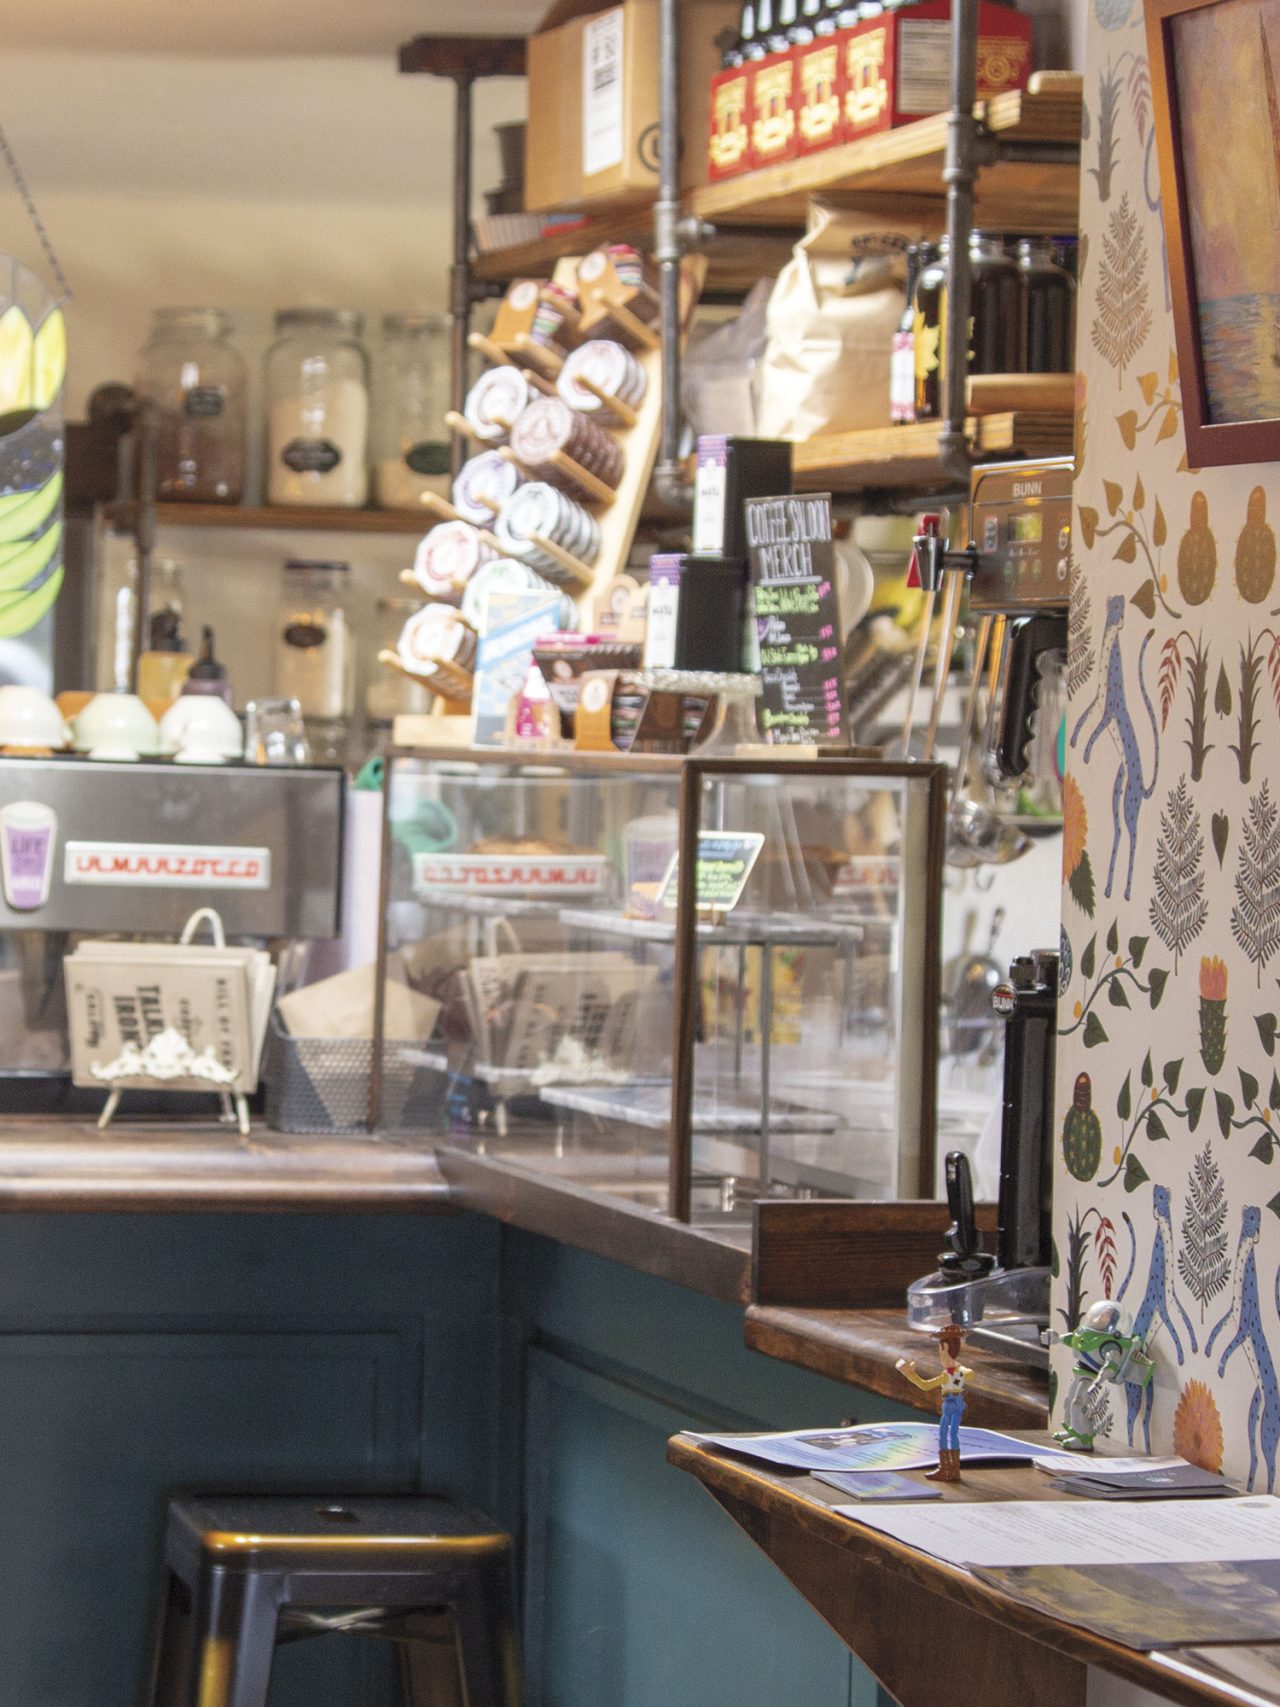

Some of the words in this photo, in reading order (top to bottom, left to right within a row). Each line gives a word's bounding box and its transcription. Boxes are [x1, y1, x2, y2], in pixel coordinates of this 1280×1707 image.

[1012, 482, 1042, 497] BUNN
[747, 502, 791, 547] COFFEE
[788, 500, 832, 542] SALOON
[760, 543, 812, 579] MERCH
[76, 854, 101, 872] LA
